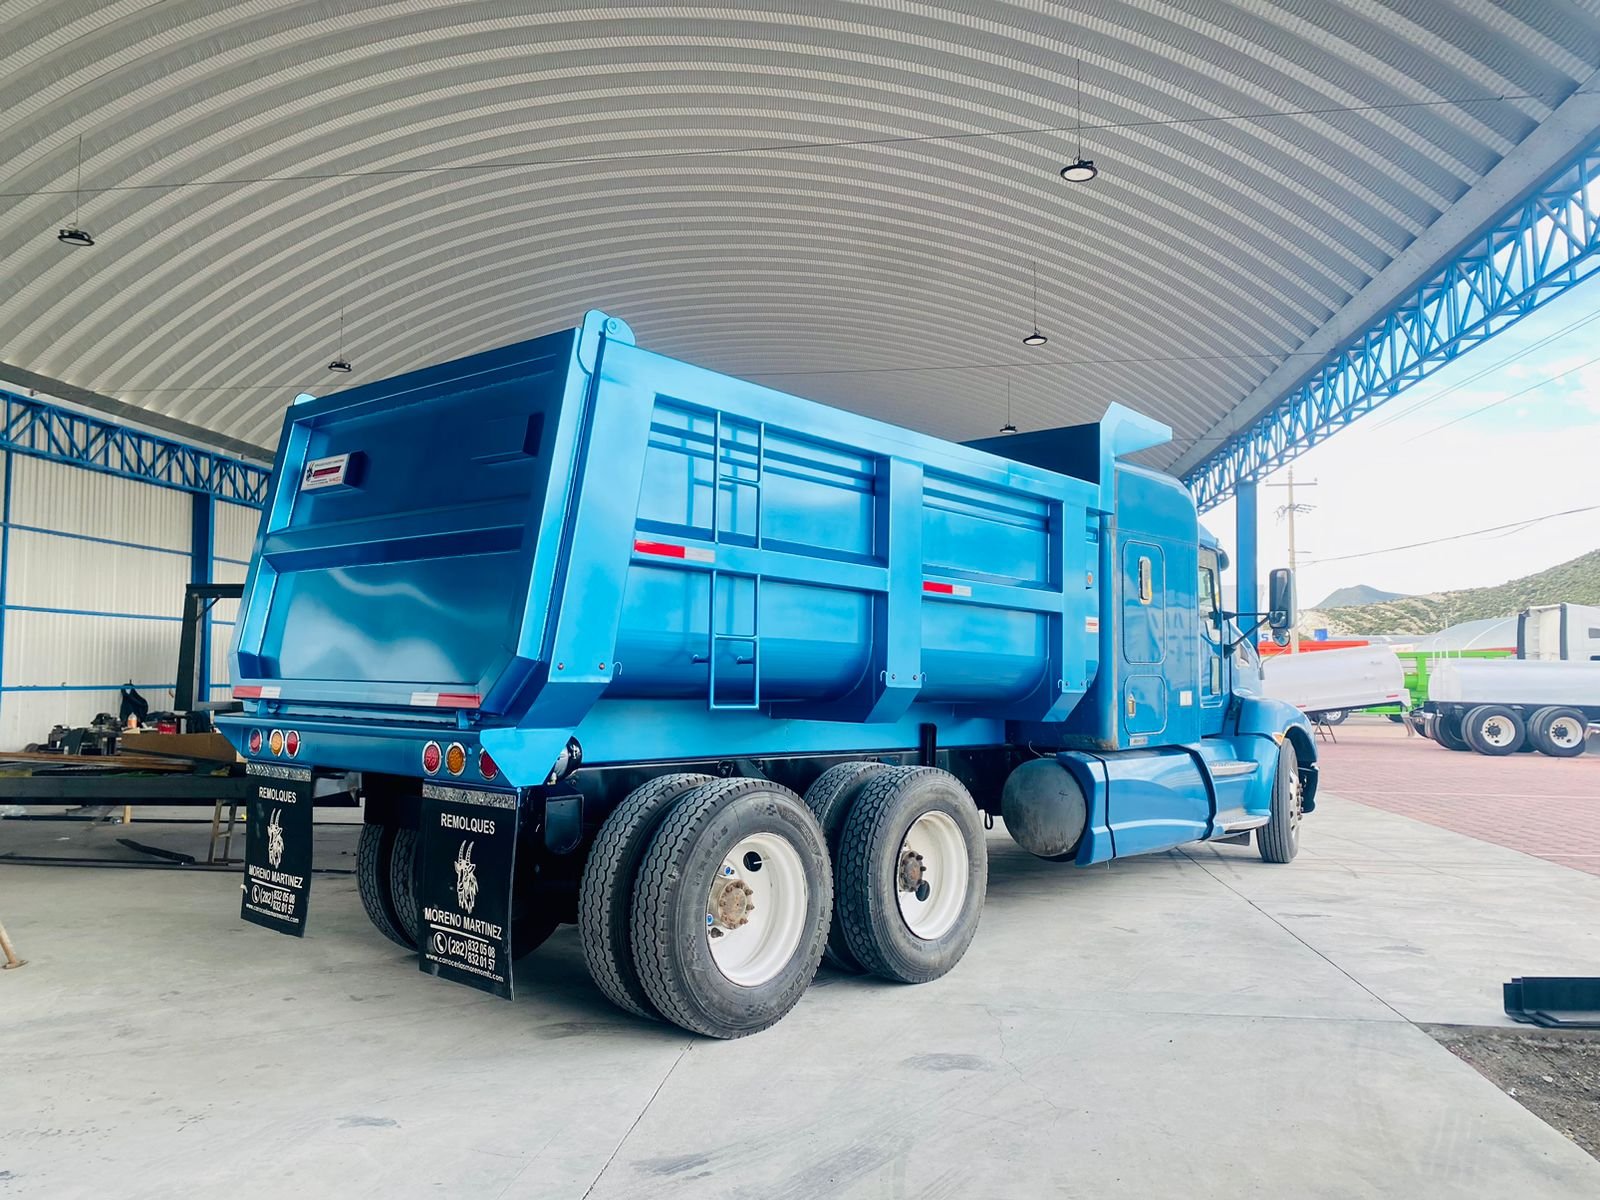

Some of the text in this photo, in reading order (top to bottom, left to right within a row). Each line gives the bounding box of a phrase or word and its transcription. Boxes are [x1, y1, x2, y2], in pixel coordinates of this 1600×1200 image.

[259, 786, 296, 803] REMOLQUES
[441, 812, 495, 835] REMOLQUES
[248, 864, 304, 888] MORENO MARTINEZ
[424, 907, 502, 940] MORENO MARTINEZ
[448, 936, 495, 959] (282) 832 05 08
[468, 952, 495, 971] 832 01 57
